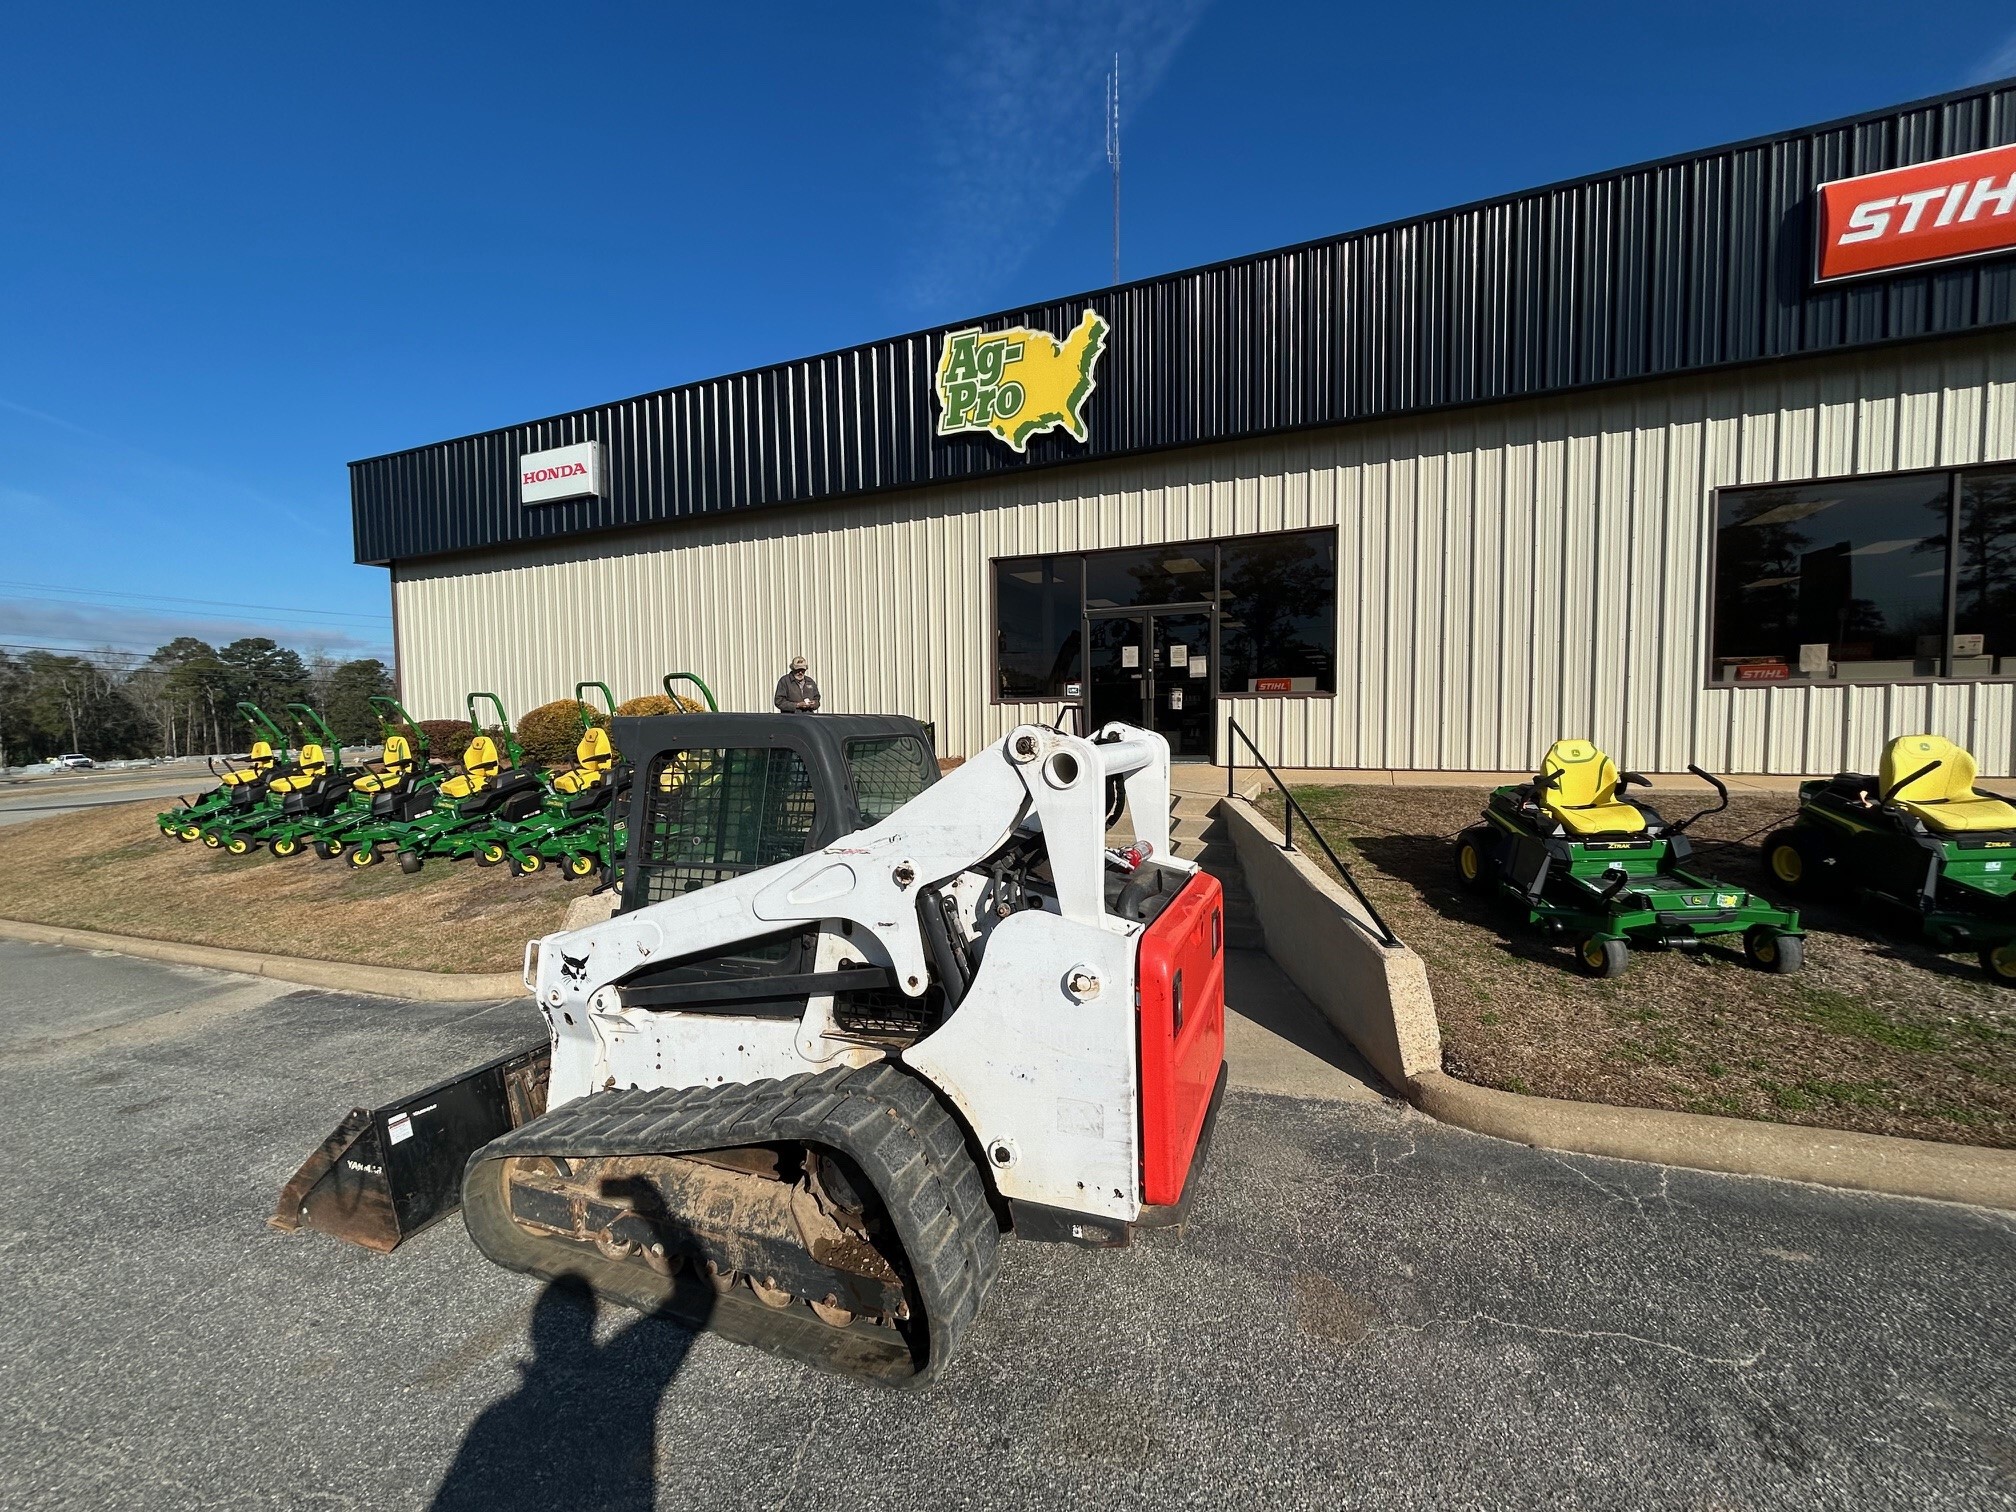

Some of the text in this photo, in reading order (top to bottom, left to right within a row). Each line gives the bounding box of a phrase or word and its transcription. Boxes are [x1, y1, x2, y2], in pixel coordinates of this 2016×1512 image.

[944, 334, 1023, 387] Ag-
[944, 381, 1023, 427] Pro
[523, 462, 587, 485] HONDA
[1741, 669, 1785, 679] STIHL
[1258, 682, 1287, 691] STIHL
